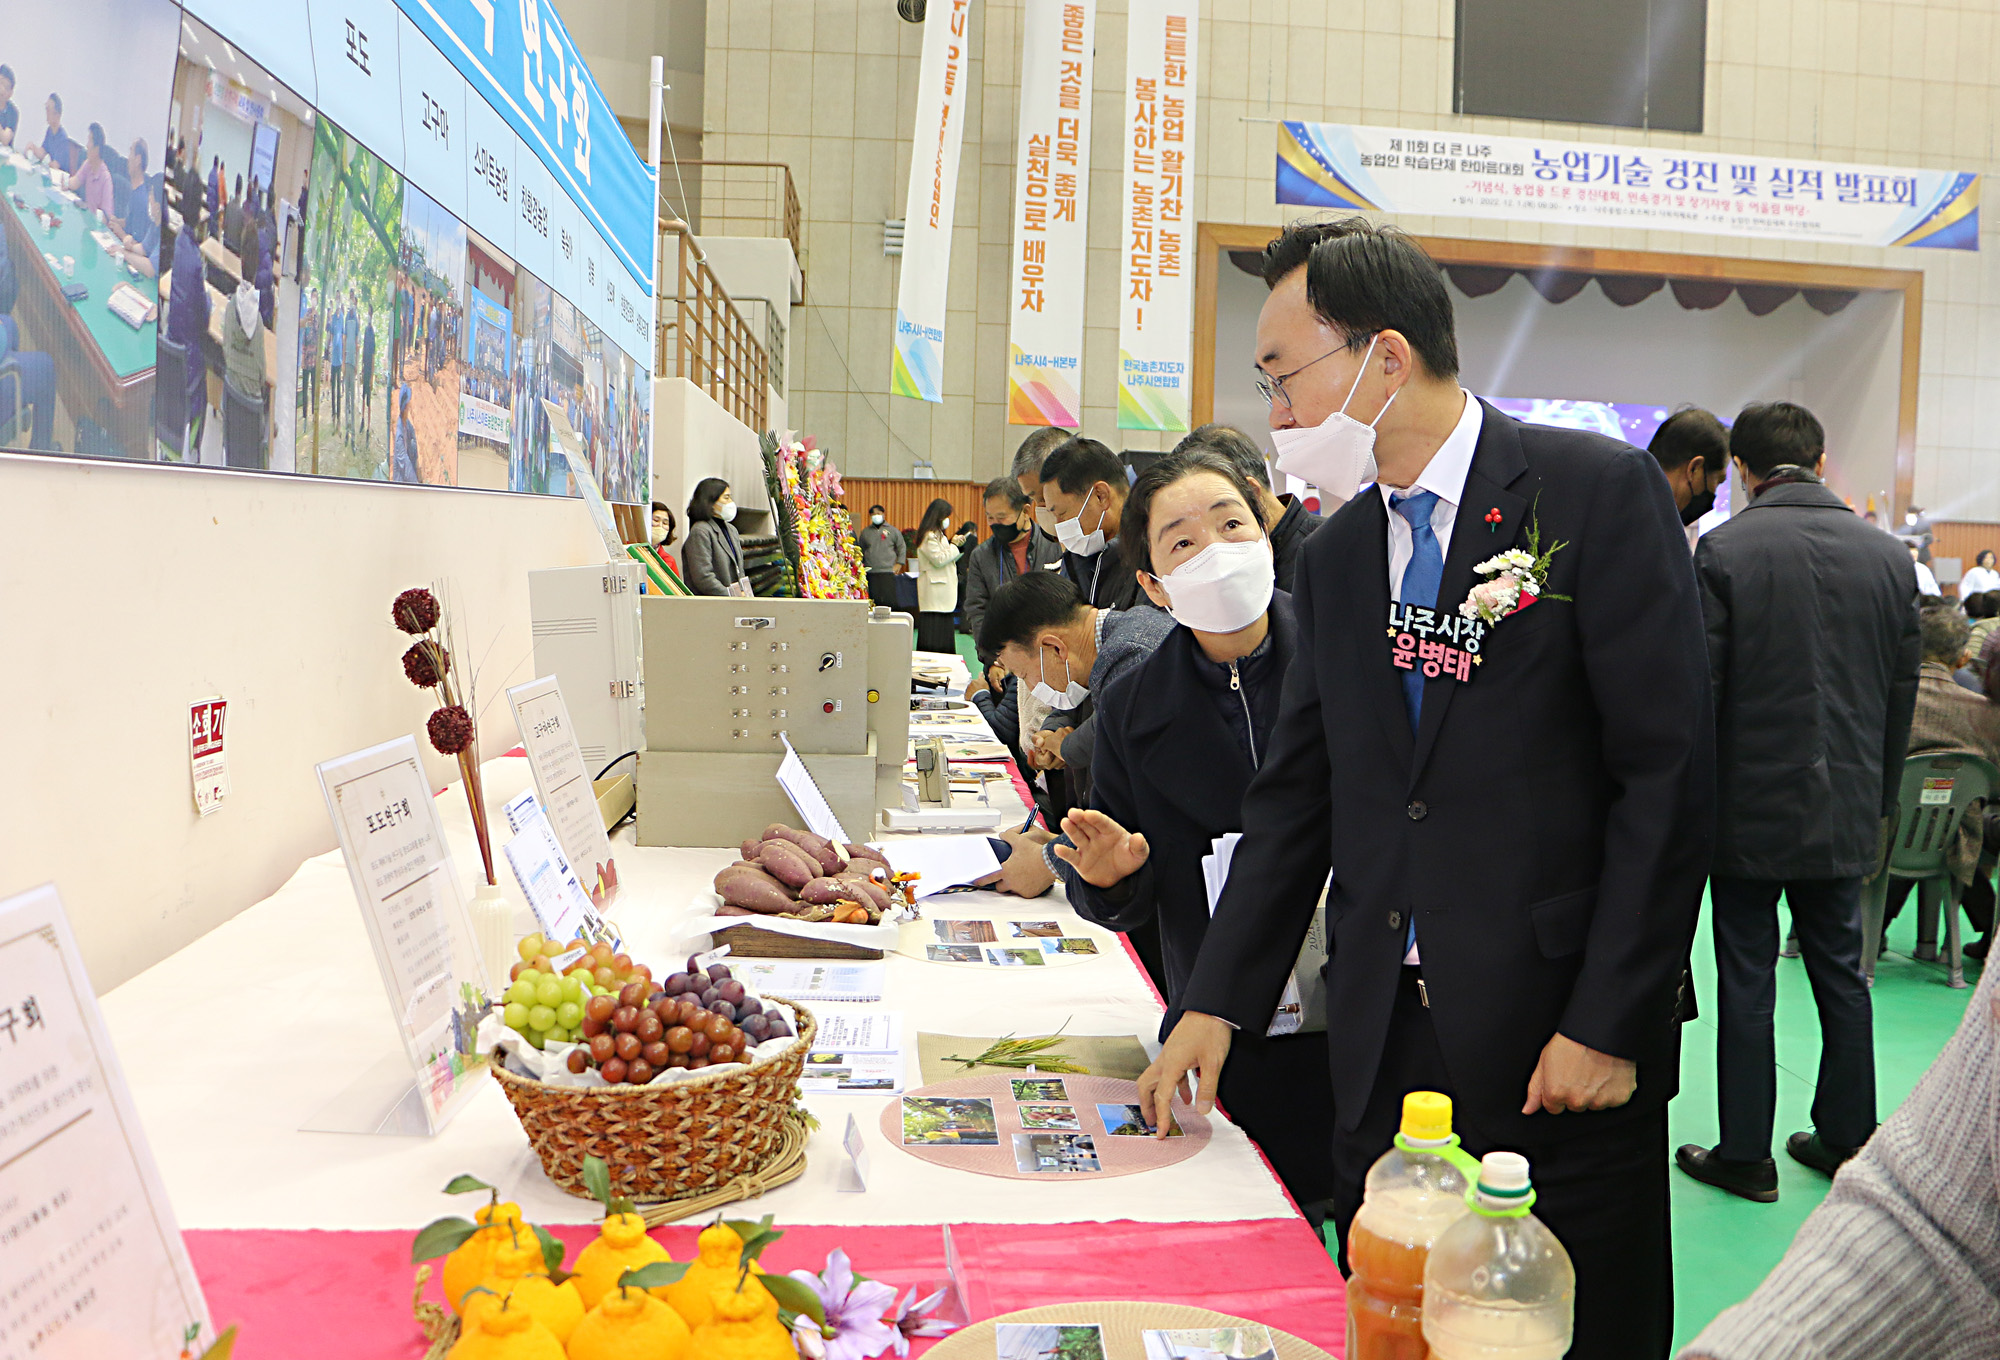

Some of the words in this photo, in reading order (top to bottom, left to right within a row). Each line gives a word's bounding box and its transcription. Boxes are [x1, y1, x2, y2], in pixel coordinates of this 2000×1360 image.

[345, 17, 372, 77] 포도
[1061, 3, 1085, 54] 좋은
[1163, 15, 1188, 88] 튼튼한
[1059, 60, 1082, 111] 것을
[422, 91, 449, 151] 고구마
[1056, 116, 1080, 167] 더욱
[1133, 77, 1158, 174] 봉사하는
[1162, 94, 1185, 143] 농업
[474, 141, 509, 204] 스마트농업
[1360, 152, 1400, 168] 농업인
[1404, 155, 1457, 172] 학습단체
[1461, 158, 1525, 177] 한마음대회
[1390, 138, 1402, 153] 제
[1406, 139, 1429, 154] 11회
[1433, 141, 1446, 156] 더
[1450, 142, 1463, 157] 큰
[1466, 143, 1493, 158] 나주
[1024, 133, 1051, 232] 실천으로
[1053, 172, 1077, 222] 좋게
[1160, 149, 1185, 222] 활기찬
[1531, 147, 1654, 189] 농업기술
[1662, 158, 1718, 194] 경진
[1730, 163, 1758, 197] 및
[1767, 167, 1824, 201] 실적
[1835, 171, 1918, 208] 발표회
[1551, 186, 1571, 200] 드론
[521, 184, 549, 239] 친환경농업
[1129, 180, 1154, 303] 농촌지도자
[1158, 228, 1182, 278] 농촌
[1021, 239, 1046, 313] 배우자
[1015, 353, 1078, 370] 나주시4-H본부
[1123, 359, 1185, 375] 한국농촌지도자
[1127, 374, 1180, 389] 나주시연합회
[1388, 602, 1486, 654] 나주시장
[1391, 632, 1473, 684] 윤병태
[366, 797, 413, 834] 포도연구회
